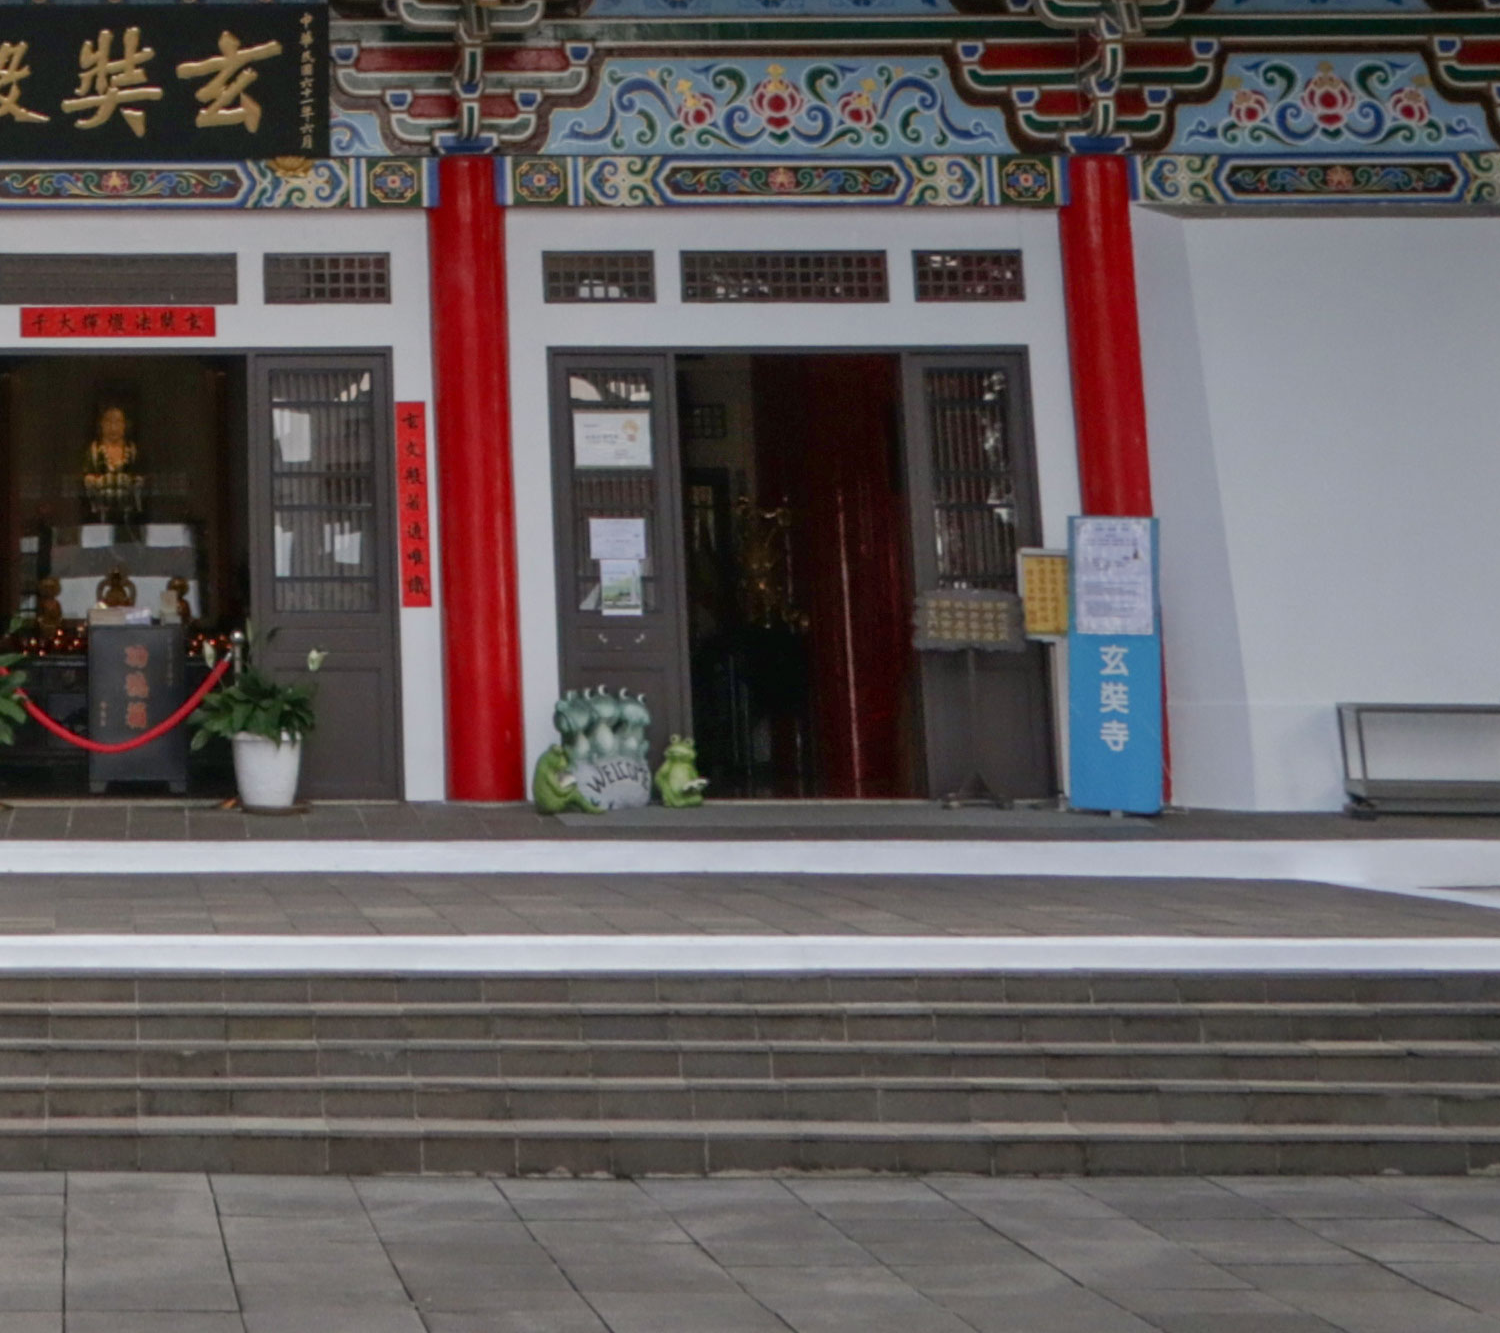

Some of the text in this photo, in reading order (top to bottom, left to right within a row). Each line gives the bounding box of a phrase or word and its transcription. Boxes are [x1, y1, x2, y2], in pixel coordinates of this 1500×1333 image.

[1099, 644, 1130, 753] 玄奘寺
[586, 761, 650, 795] WELCOME
